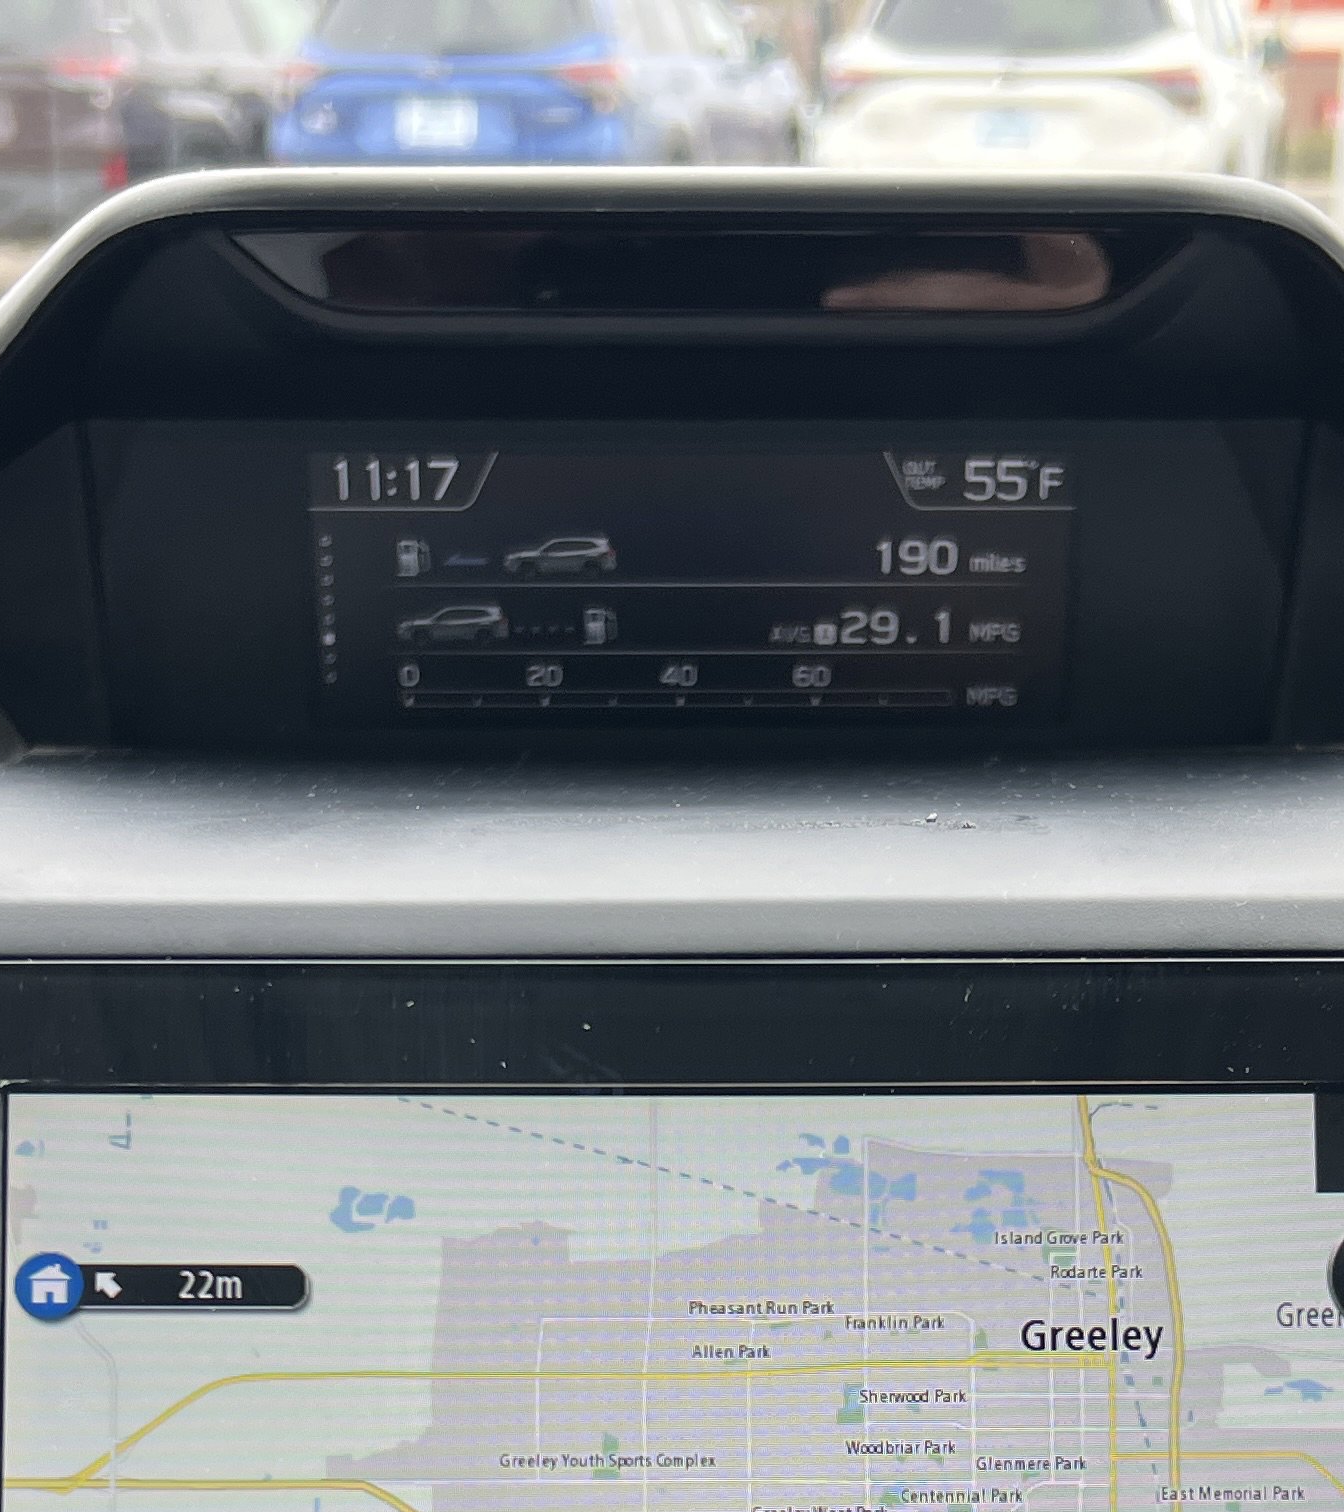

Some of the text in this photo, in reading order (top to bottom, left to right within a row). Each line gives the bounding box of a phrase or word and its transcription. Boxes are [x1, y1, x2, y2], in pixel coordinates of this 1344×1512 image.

[332, 459, 461, 503] 11:17
[876, 539, 1027, 576] 190 miles
[840, 610, 952, 646] 29.1
[968, 624, 1022, 643] MPG
[398, 664, 832, 688] 0 20 40 60
[994, 1231, 1125, 1246] Island Grove Park
[1050, 1265, 1143, 1280] Rodarte Park
[179, 1270, 243, 1299] 22m
[688, 1300, 835, 1316] Pheasant Run Park
[845, 1315, 945, 1330] Franklin Park
[1020, 1319, 1164, 1358] Greeley
[692, 1344, 771, 1359] Allen Park
[859, 1389, 967, 1404] Sherwood Park
[845, 1440, 956, 1455] Woodbriar Park
[499, 1453, 716, 1470] Greeley Youth Sports Complex
[976, 1456, 1087, 1471] Glenmere Park
[901, 1488, 1023, 1504] Centennial Park
[1161, 1487, 1305, 1502] East Memorial Park
